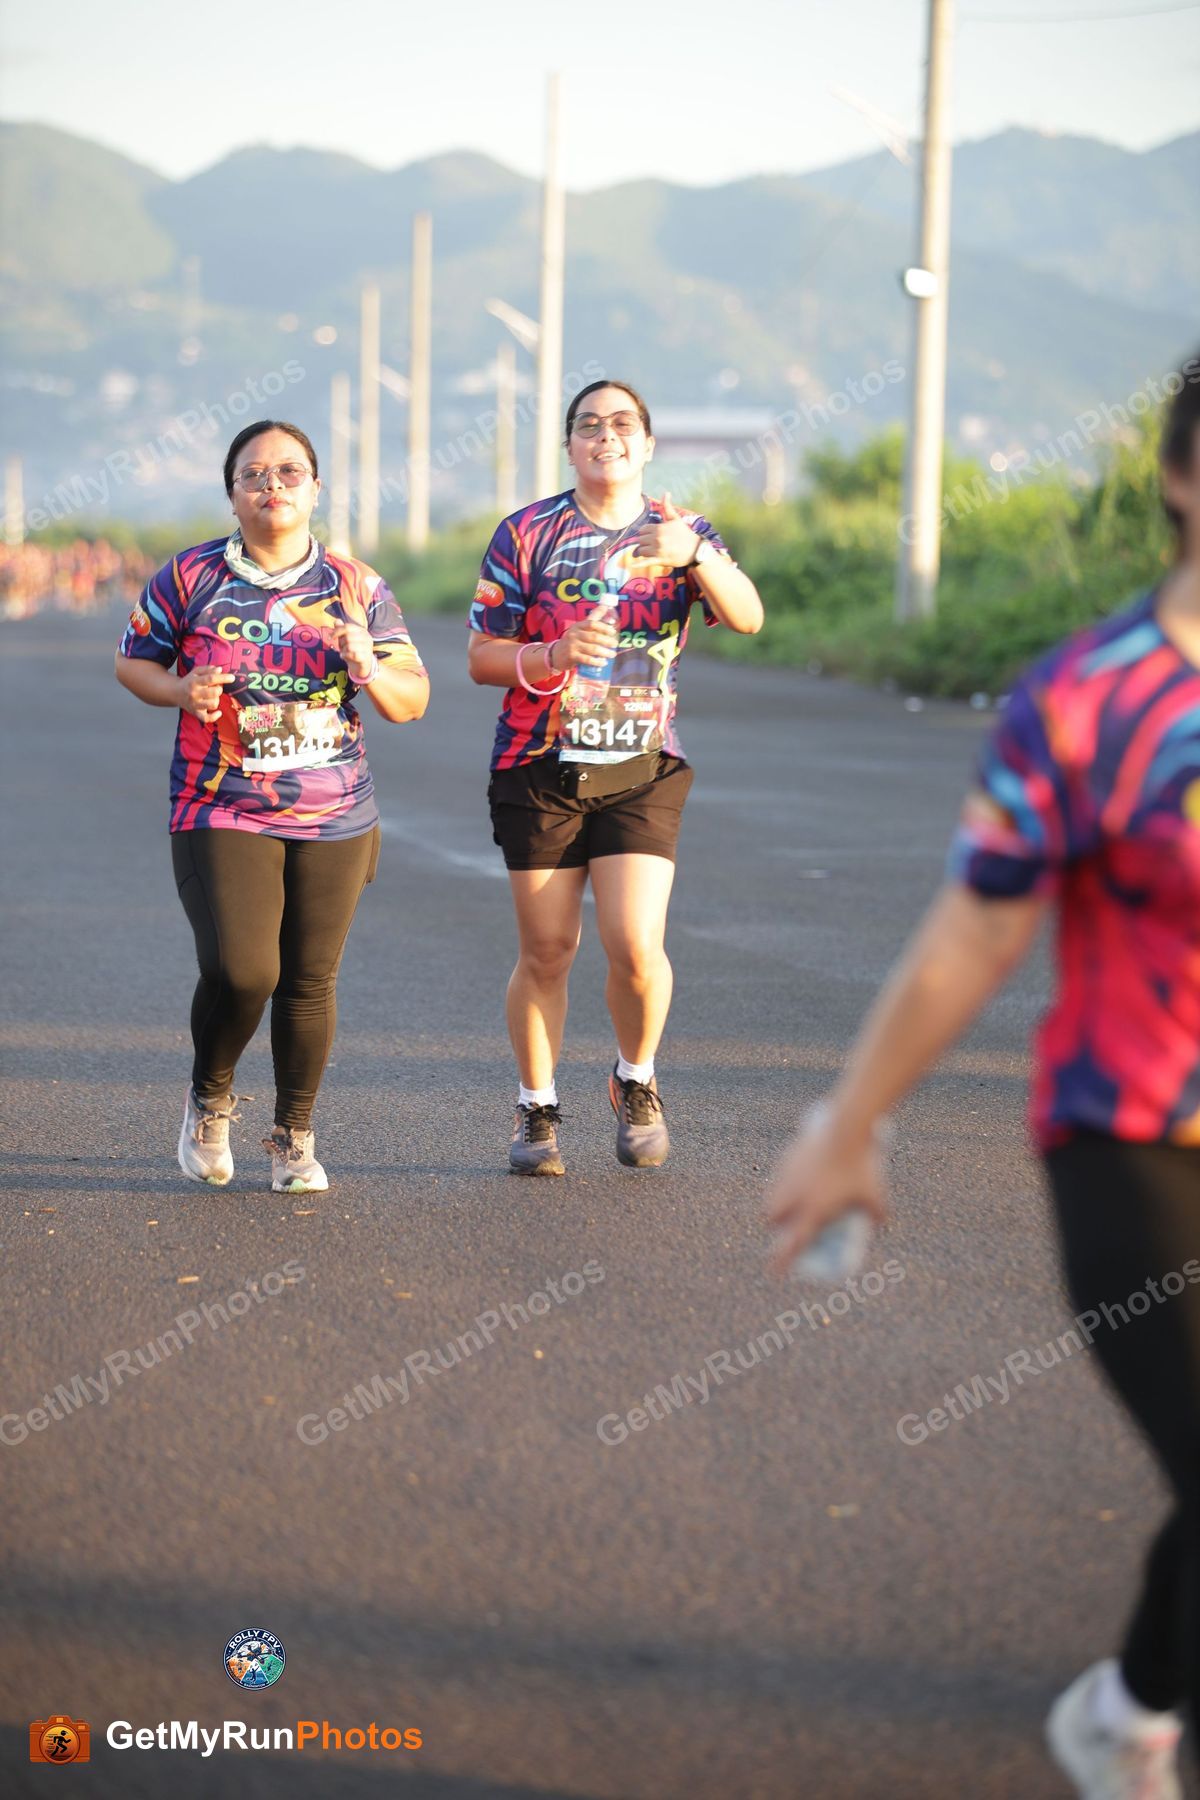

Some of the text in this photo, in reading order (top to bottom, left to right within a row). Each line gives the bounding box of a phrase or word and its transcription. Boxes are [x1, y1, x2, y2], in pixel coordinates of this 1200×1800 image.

[618, 631, 647, 648] 26
[230, 642, 325, 678] RUN
[247, 672, 310, 694] 2026
[565, 718, 657, 746] 13147
